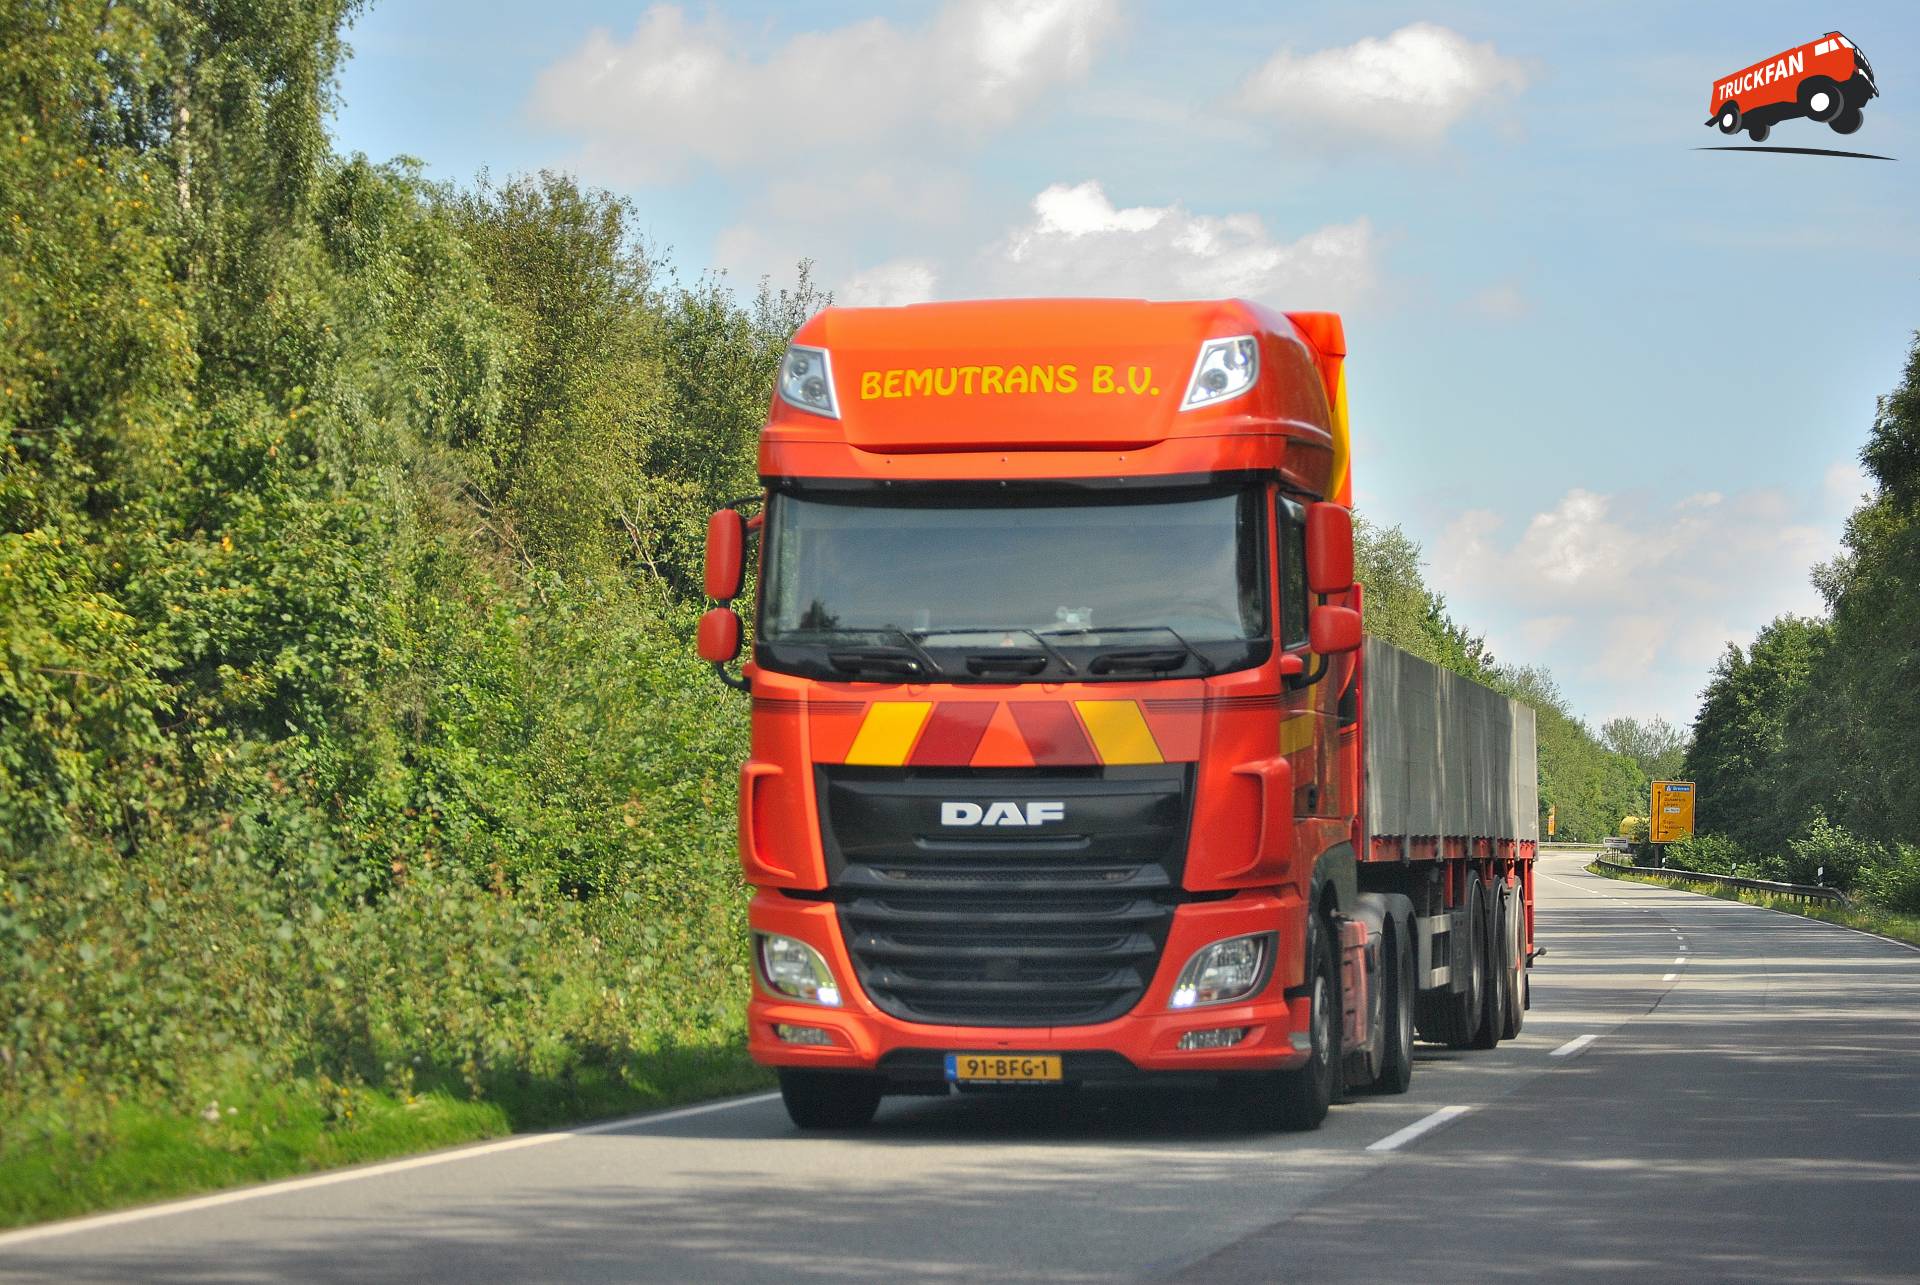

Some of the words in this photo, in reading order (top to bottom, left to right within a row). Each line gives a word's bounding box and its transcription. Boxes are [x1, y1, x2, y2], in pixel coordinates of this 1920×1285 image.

[860, 364, 1078, 400] BEMUTRANS
[1092, 364, 1160, 395] B.V.
[941, 802, 1065, 825] DAF
[967, 1060, 1048, 1076] 91-BFG-1
